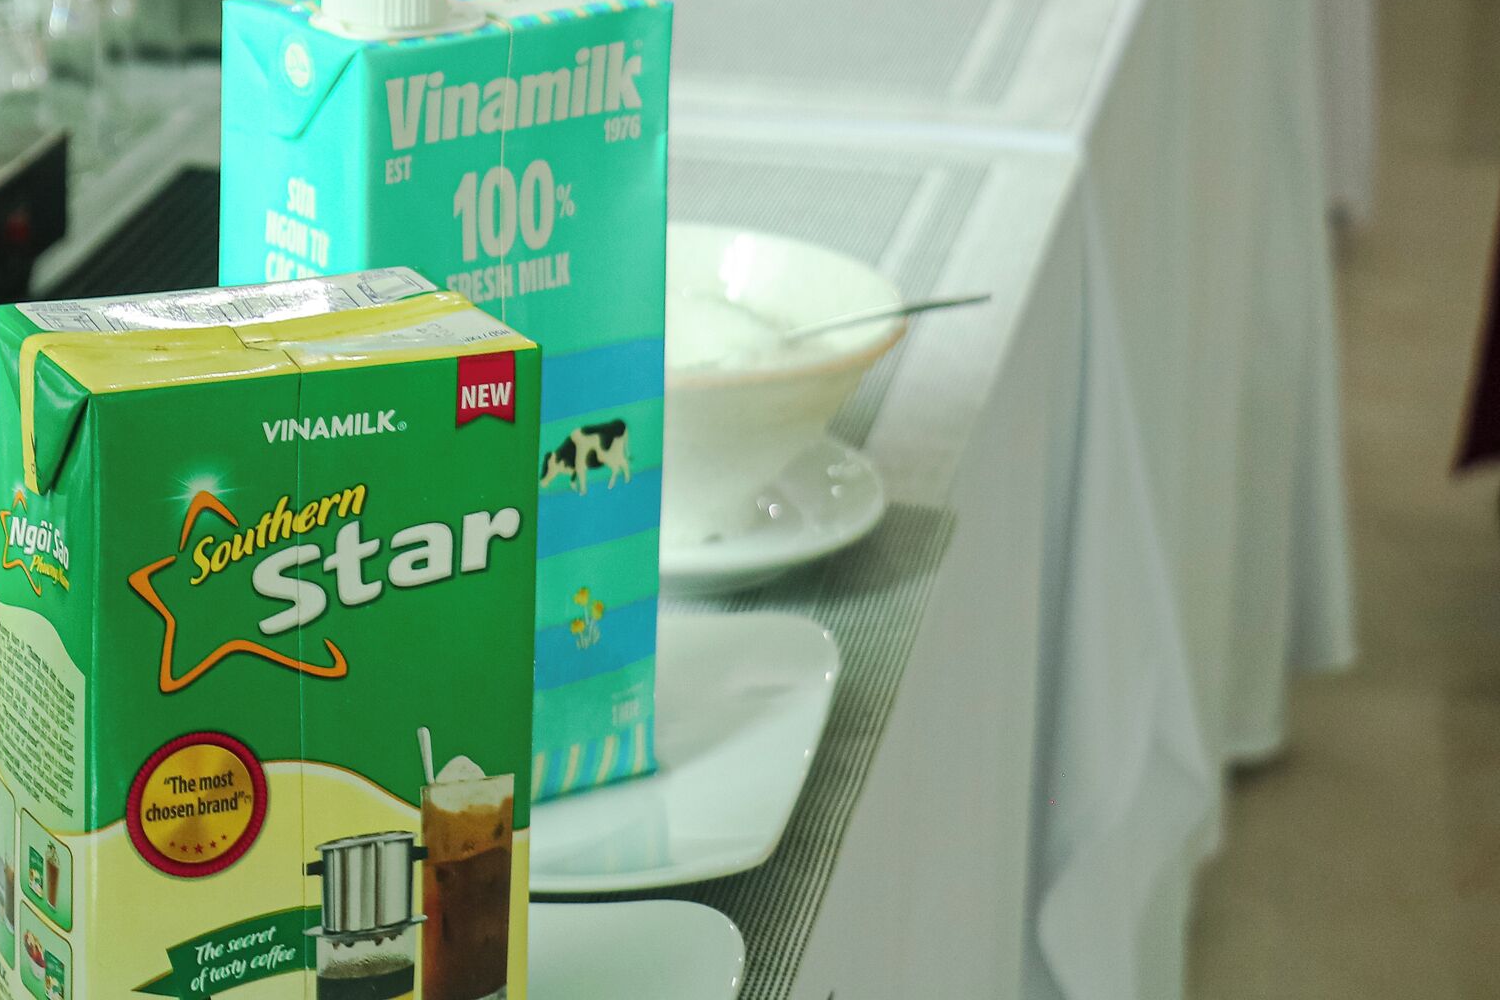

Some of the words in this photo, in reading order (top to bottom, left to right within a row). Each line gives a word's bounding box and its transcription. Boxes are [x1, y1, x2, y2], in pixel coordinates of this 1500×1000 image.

[385, 41, 643, 151] Vinamilk
[603, 114, 642, 144] 1976
[385, 155, 412, 185] EST
[453, 159, 577, 263] 100%
[446, 264, 514, 304] FRESH
[518, 251, 571, 296] MILK
[460, 381, 513, 410] NEW
[262, 408, 396, 444] VINAMILK
[9, 516, 53, 556] Ngôi
[52, 528, 69, 571] Sao
[190, 483, 367, 586] Southern
[251, 506, 522, 636] Star
[199, 769, 235, 791] most
[145, 803, 195, 823] chosen
[190, 966, 209, 993] of
[209, 958, 247, 984] tasty
[250, 943, 297, 970] coffee
[195, 941, 225, 966] The
[227, 925, 277, 954] secret
